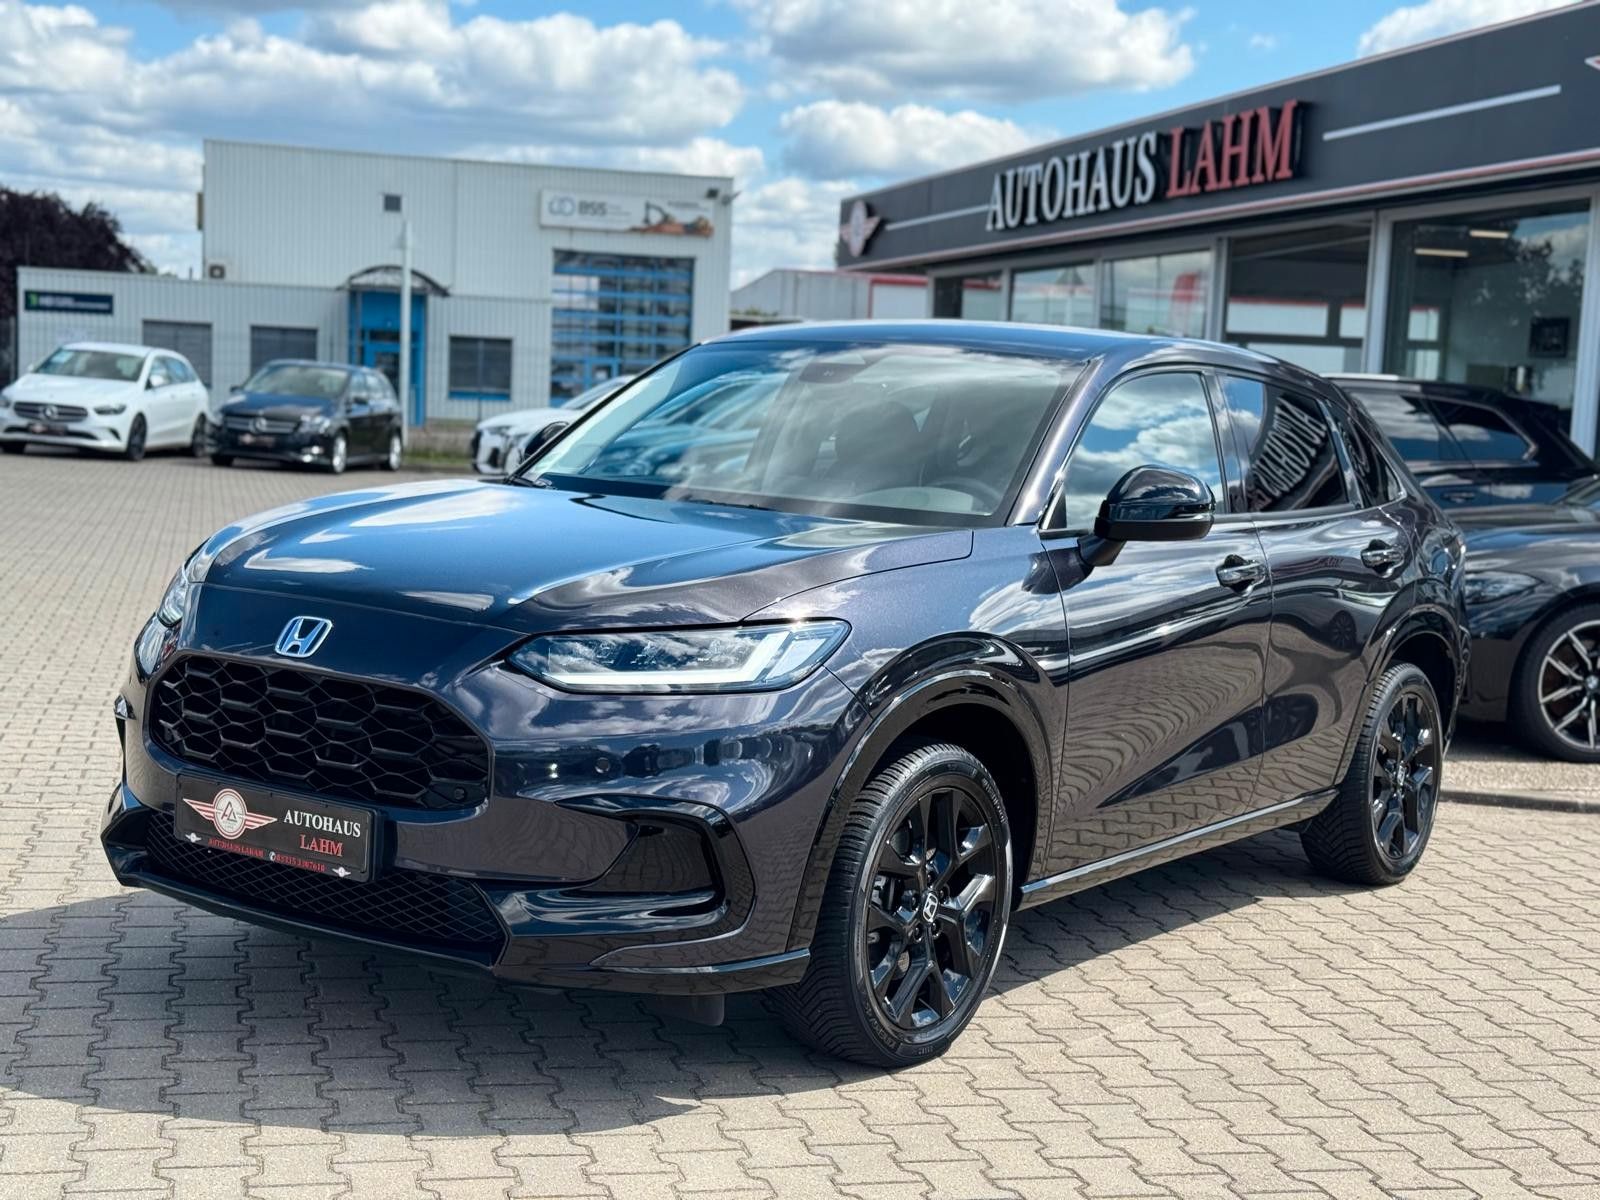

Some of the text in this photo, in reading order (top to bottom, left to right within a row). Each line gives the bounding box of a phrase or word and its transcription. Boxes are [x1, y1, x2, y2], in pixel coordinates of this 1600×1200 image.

[985, 100, 1298, 231] AUTOHAUS LAHM
[284, 809, 361, 838] AUTOHAUS
[300, 834, 343, 857] LAHM
